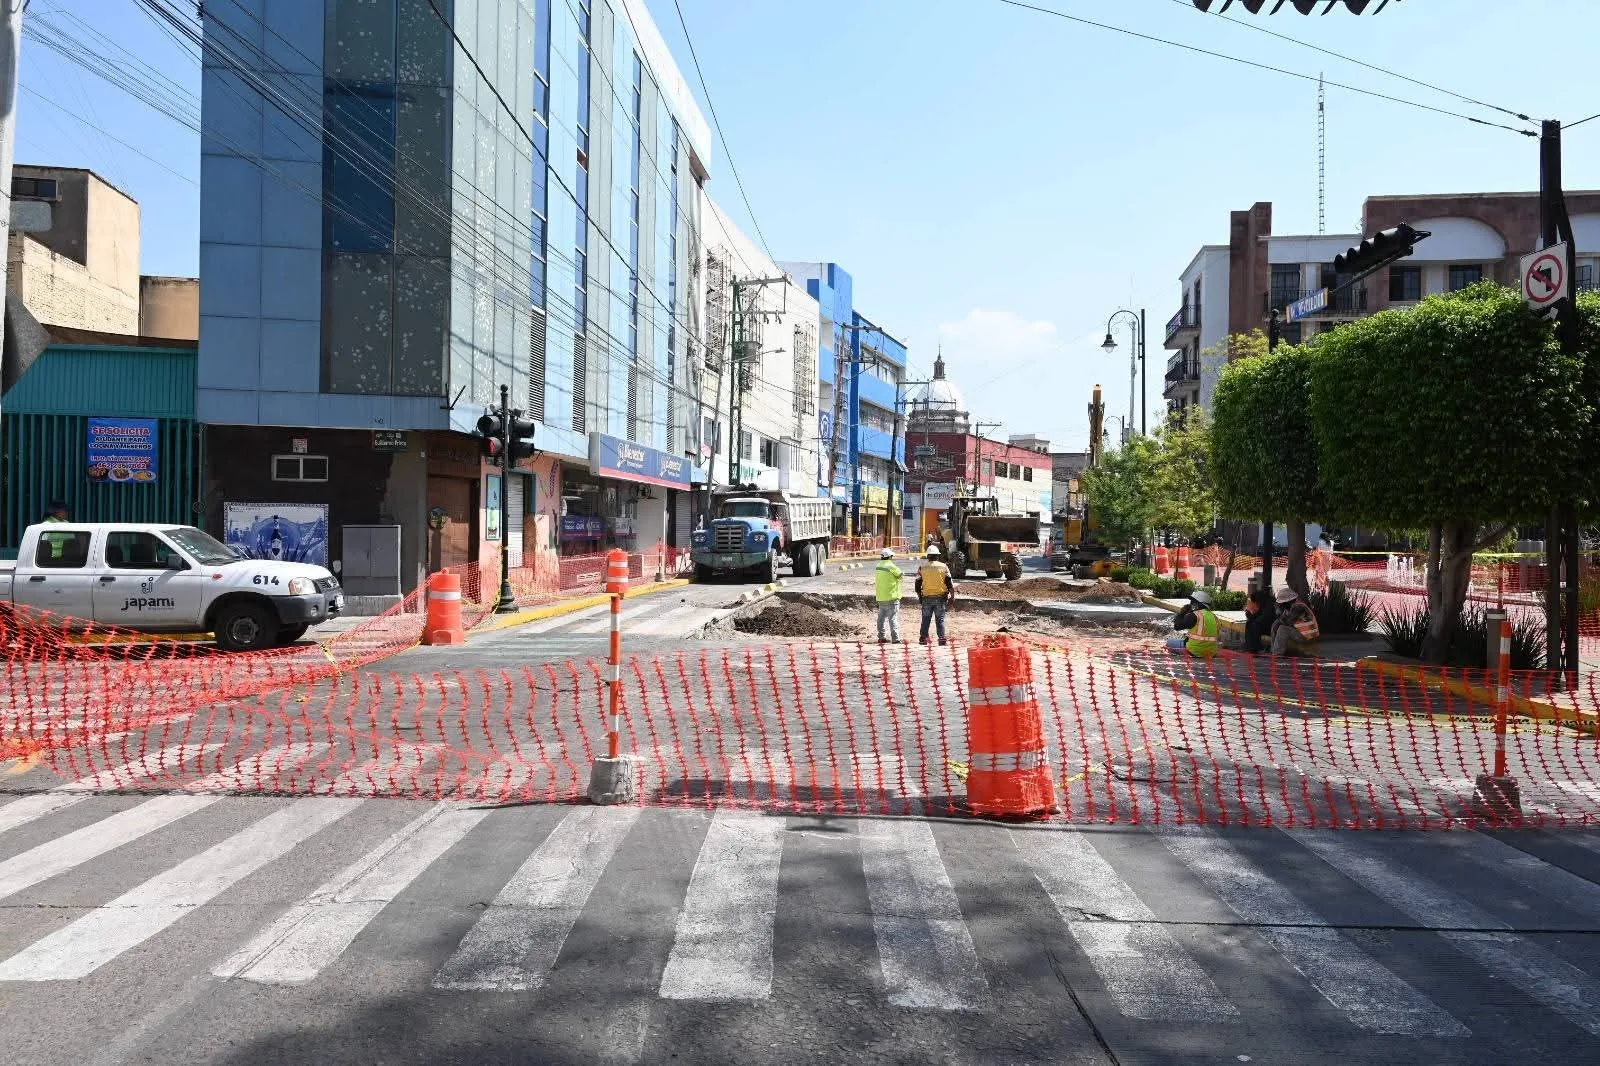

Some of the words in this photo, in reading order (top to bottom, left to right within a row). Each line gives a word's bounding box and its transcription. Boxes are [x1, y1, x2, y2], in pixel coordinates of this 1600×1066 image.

[92, 427, 104, 435] SE
[105, 427, 151, 436] SOLICITA
[253, 575, 279, 585] 614
[121, 598, 174, 611] japami
